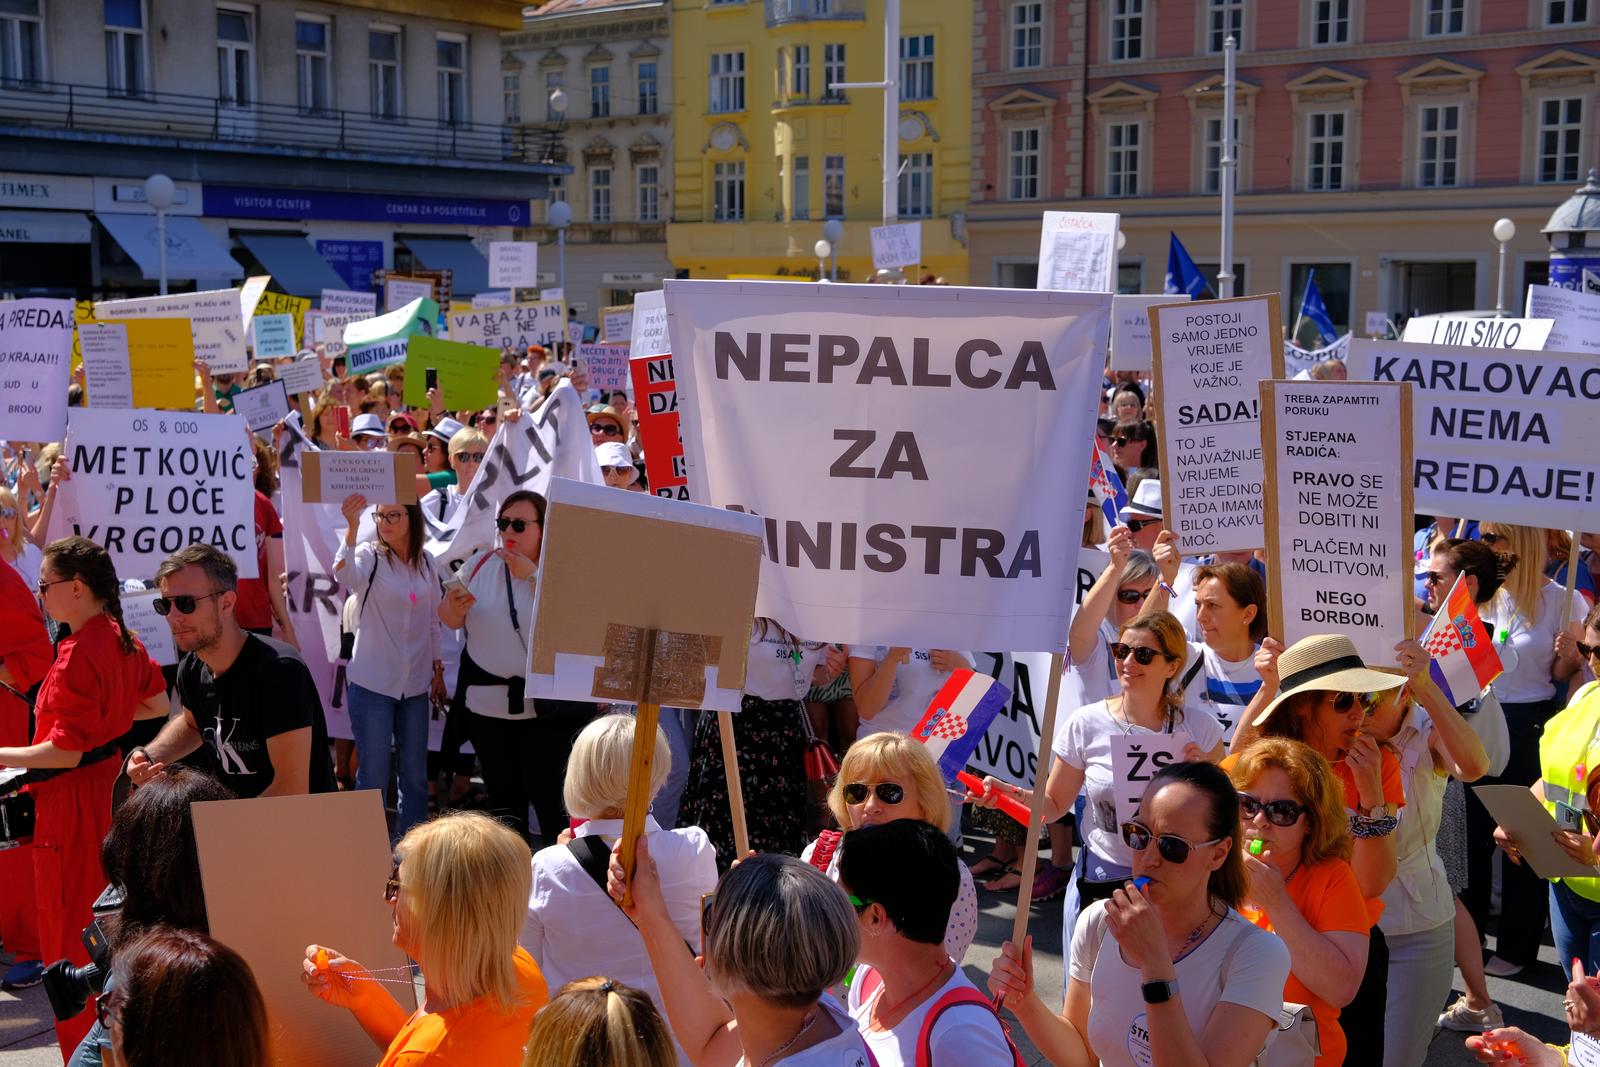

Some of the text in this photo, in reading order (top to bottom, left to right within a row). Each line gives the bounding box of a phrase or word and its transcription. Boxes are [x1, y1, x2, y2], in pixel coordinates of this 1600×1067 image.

[234, 197, 311, 210] VISITOR CENTER
[385, 203, 487, 217] CENTAR ZA POSJETITELJE
[455, 303, 561, 328] VARAŽDIN
[1185, 312, 1242, 327] POSTOJI
[483, 320, 536, 336] SE NE
[1171, 326, 1258, 343] SAMO JEDNO
[1431, 320, 1440, 345] I
[1443, 320, 1468, 346] MI
[1470, 320, 1522, 349] SMO
[9, 351, 59, 365] KRAJA!!!
[1187, 342, 1244, 357] VRIJEME
[714, 331, 1057, 391] NEPALCA
[1190, 360, 1243, 374] KOJE JE
[3, 380, 39, 389] SUD U
[1192, 375, 1242, 389] VAŽNO.
[1284, 394, 1379, 406] TREBA ZAPAMTITI
[8, 404, 42, 414] BRODU
[1178, 399, 1258, 425] SADA!
[1285, 406, 1329, 416] PORUKU
[132, 419, 198, 434] OS & ODO
[1430, 406, 1551, 444] NEMA
[1175, 436, 1216, 450] TO JE
[1285, 430, 1356, 444] STJEPANA
[829, 428, 929, 480] ZA
[1176, 448, 1262, 466] NAJVAŽNIJE
[1286, 443, 1340, 459] RADIĆA:
[71, 443, 246, 480] METKOVIĆ
[1177, 466, 1239, 482] VRIJEME
[1292, 471, 1383, 489] PRAVO SE
[1413, 458, 1595, 503] REDAJE!
[114, 480, 225, 515] PLOČE
[1178, 482, 1262, 499] JER JEDINO
[1179, 502, 1218, 515] TADA
[1298, 491, 1378, 510] NE MOŽE
[1180, 513, 1264, 531] BILO KAKVU
[1298, 511, 1379, 529] DOBITI NI
[72, 523, 247, 554] VRGORAC
[1292, 537, 1386, 558] PLAČEM NI
[1291, 558, 1389, 579] MOLITVOM,
[1316, 590, 1367, 607] NEGO
[1300, 608, 1384, 628] BORBOM.
